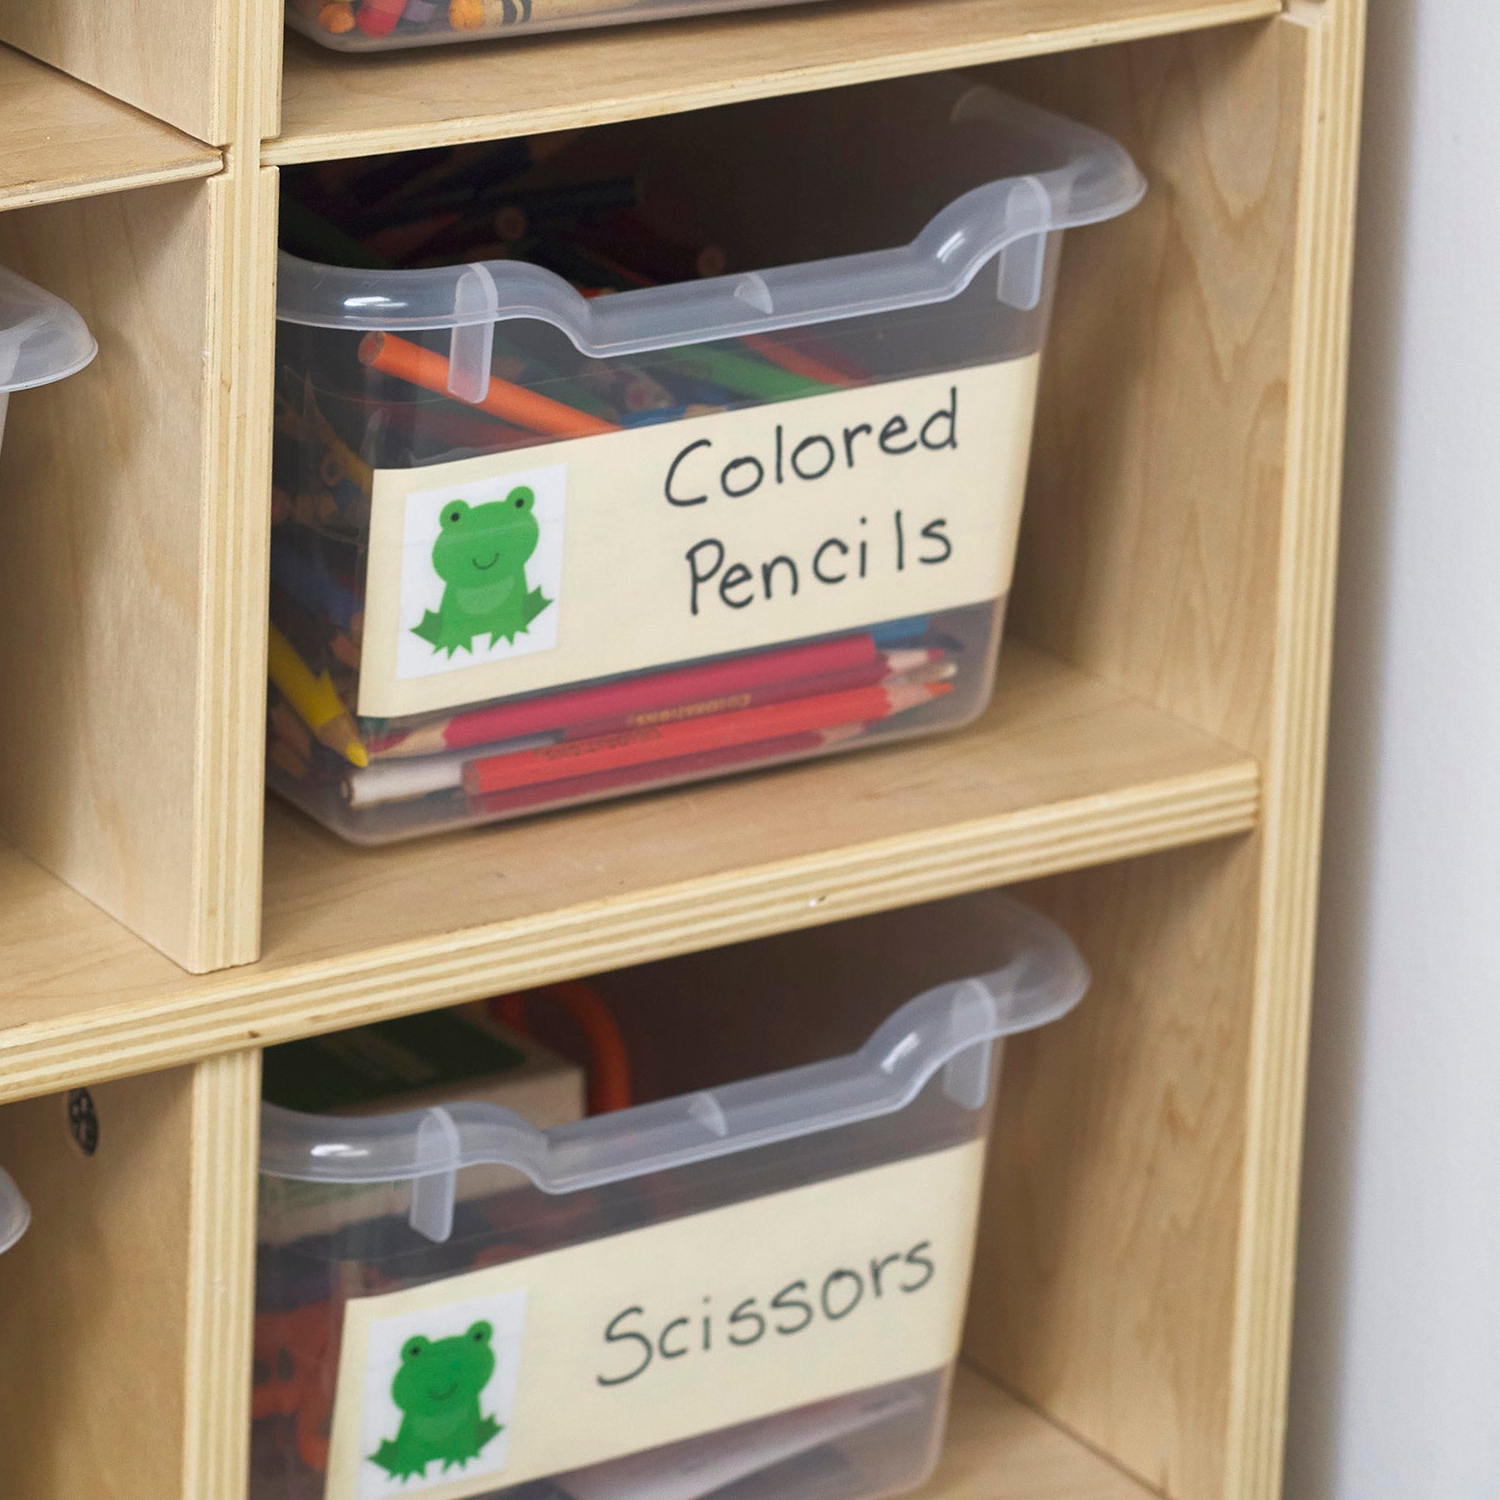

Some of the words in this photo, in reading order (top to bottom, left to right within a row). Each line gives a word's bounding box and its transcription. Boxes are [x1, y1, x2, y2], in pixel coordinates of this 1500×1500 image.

[663, 385, 959, 508] Colored
[685, 509, 953, 617] Pencils
[596, 1241, 934, 1388] Scissors
